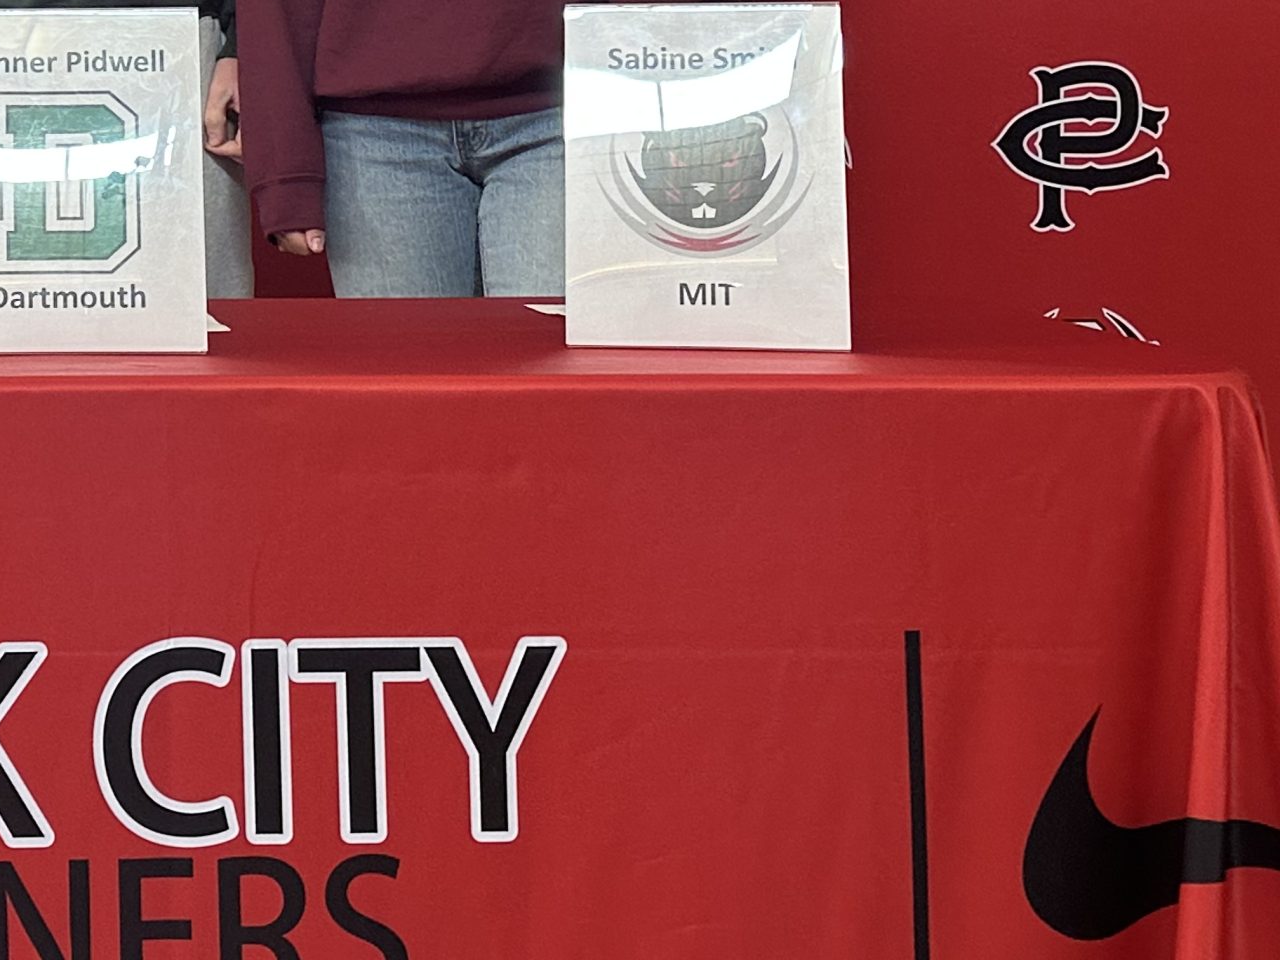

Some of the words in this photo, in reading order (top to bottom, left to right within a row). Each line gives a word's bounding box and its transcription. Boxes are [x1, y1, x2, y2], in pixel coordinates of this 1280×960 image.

[66, 49, 165, 73] Pidwell
[607, 46, 704, 70] Sabine
[678, 283, 733, 306] MIT
[93, 636, 567, 848] CITY
